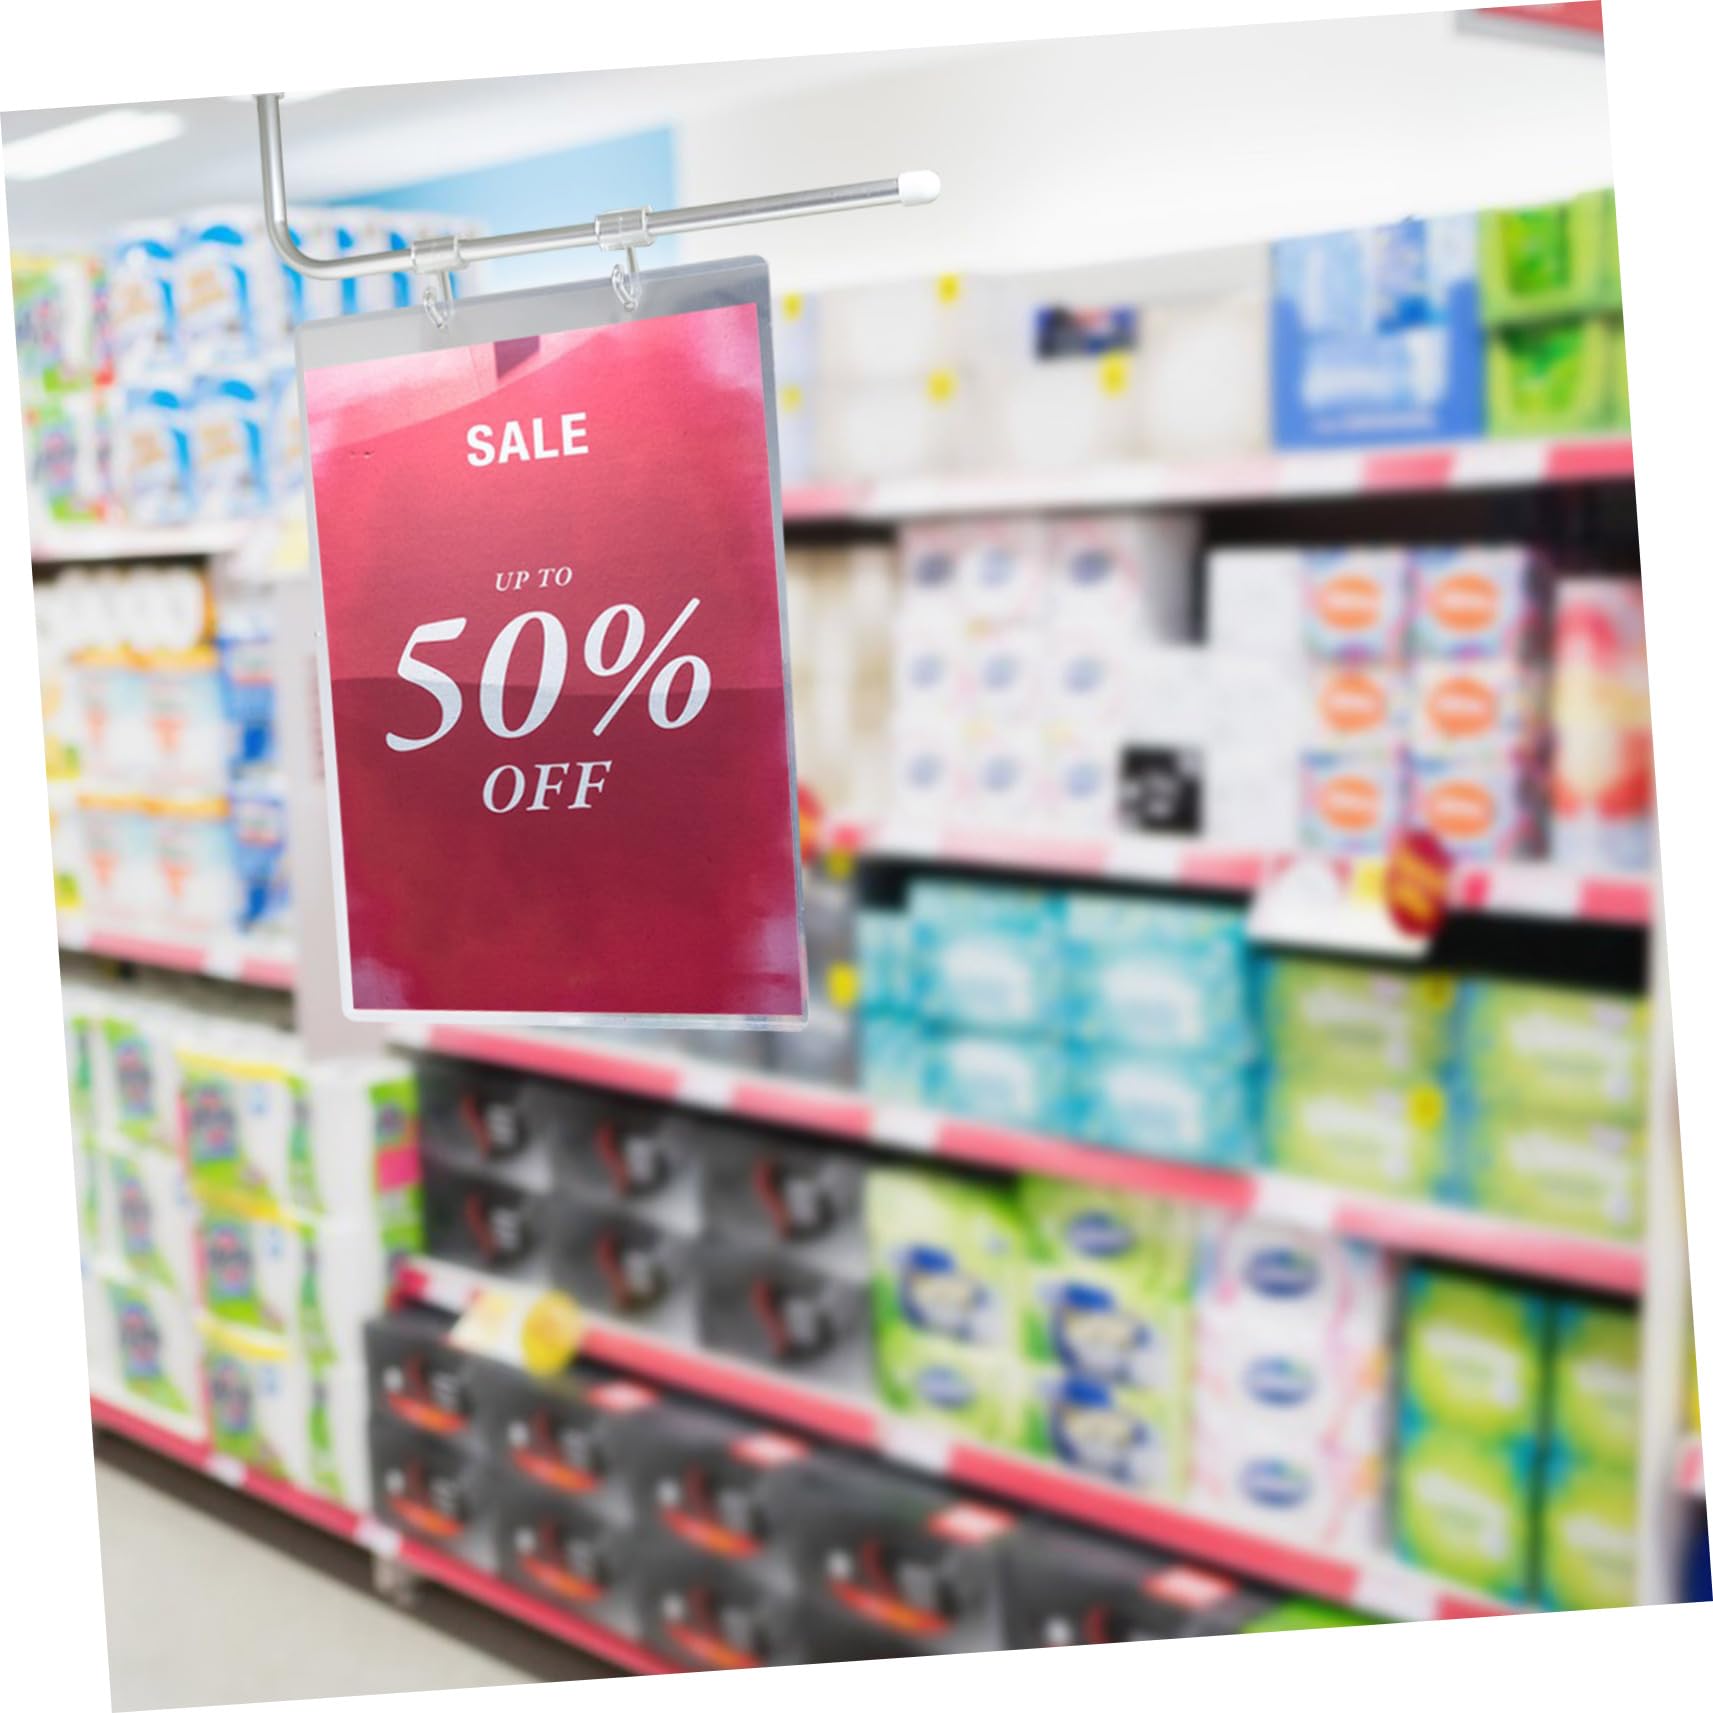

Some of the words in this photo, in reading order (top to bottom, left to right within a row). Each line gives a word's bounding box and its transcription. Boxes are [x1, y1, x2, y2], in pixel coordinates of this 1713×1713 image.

[466, 412, 589, 467] SALE
[495, 571, 530, 592] UP
[537, 566, 573, 588] TO
[385, 597, 712, 753] 50%
[482, 761, 612, 813] OFF
